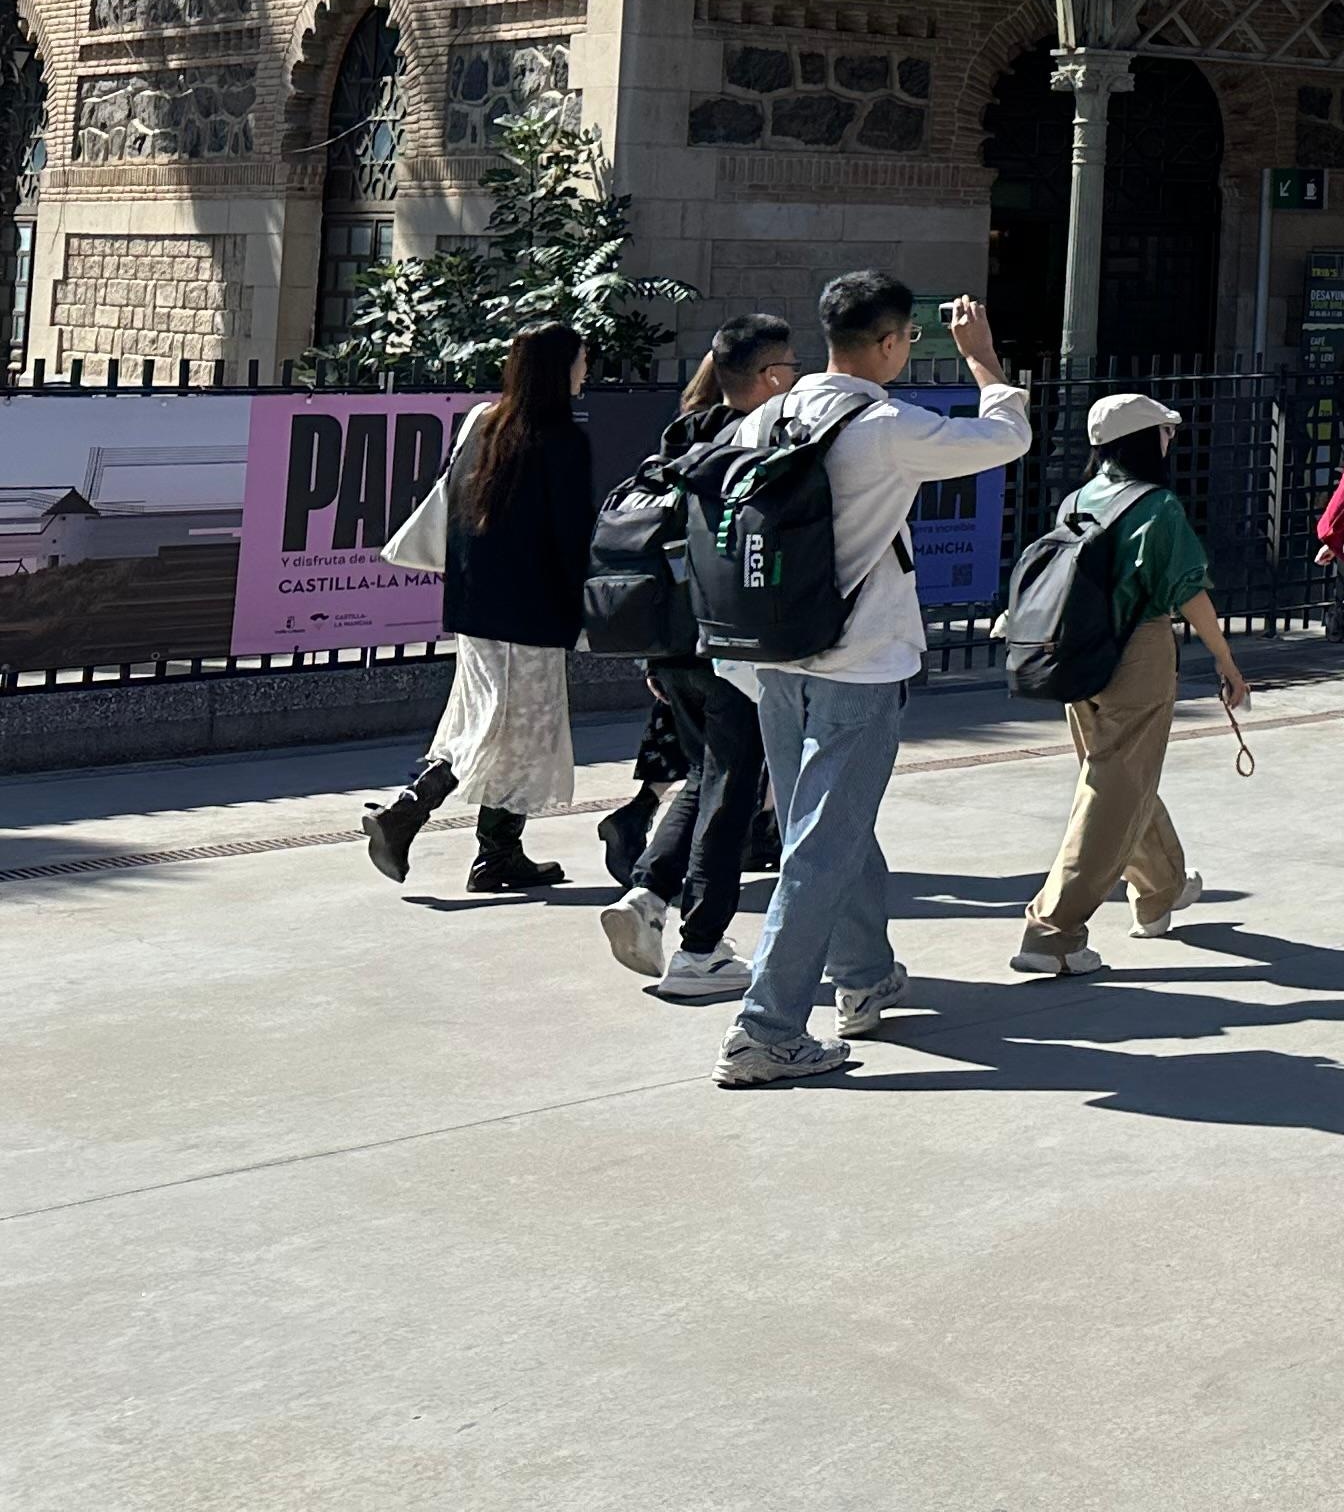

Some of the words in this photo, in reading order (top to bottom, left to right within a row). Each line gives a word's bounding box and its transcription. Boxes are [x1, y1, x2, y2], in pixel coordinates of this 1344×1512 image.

[281, 412, 468, 552] PAR
[914, 542, 974, 555] MANCHA
[281, 557, 290, 568] Y
[293, 555, 346, 568] disfruta
[349, 554, 366, 565] de
[750, 534, 765, 588] ACG
[278, 574, 399, 594] CASTILLA-LA
[404, 571, 446, 587] MAN
